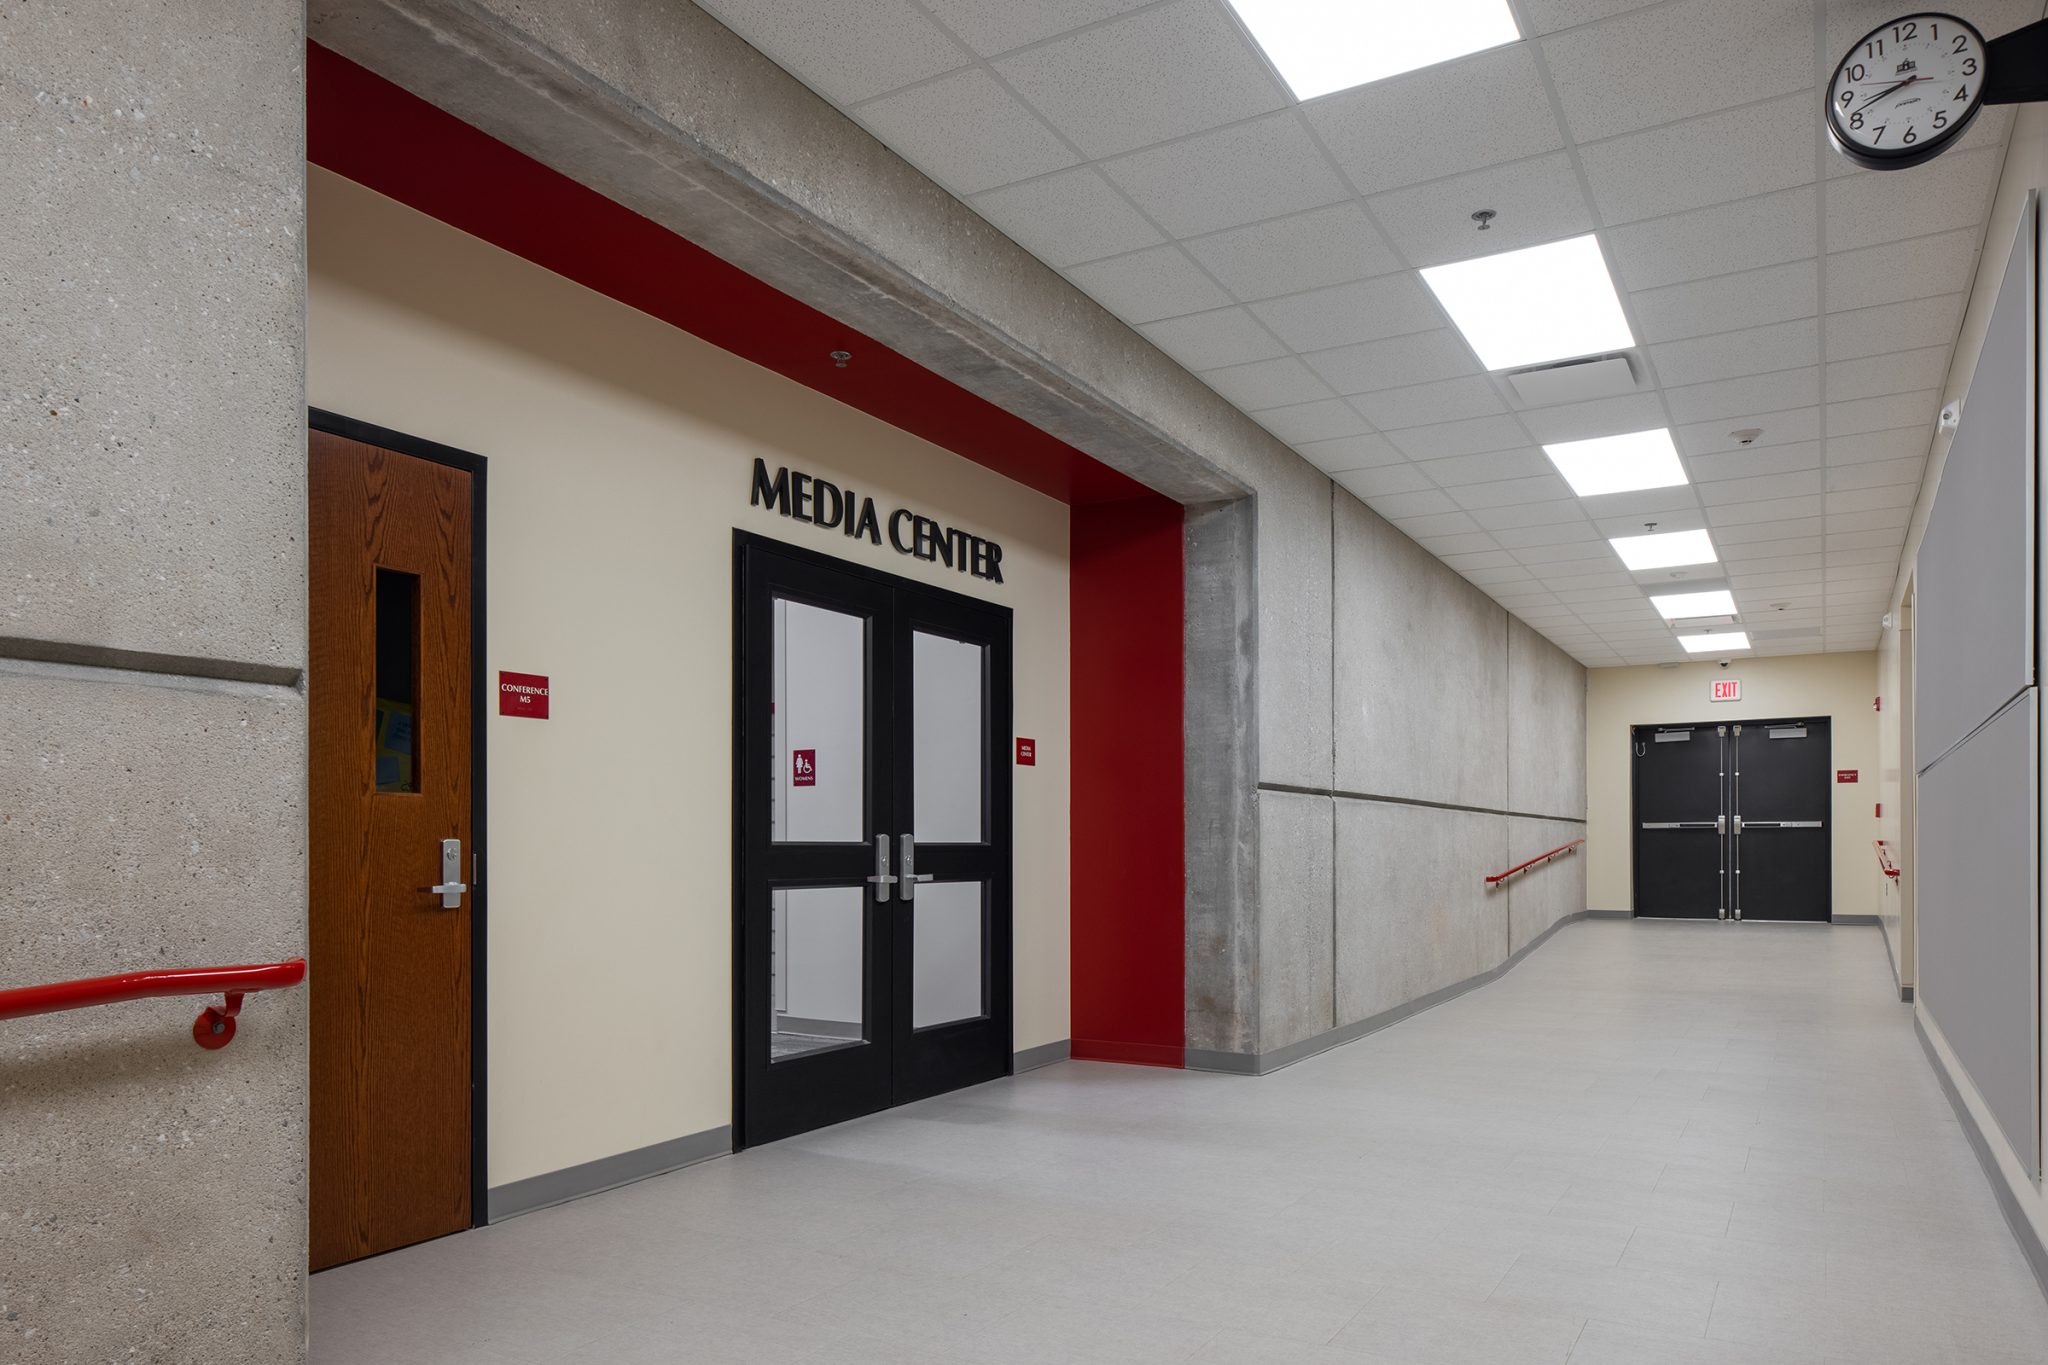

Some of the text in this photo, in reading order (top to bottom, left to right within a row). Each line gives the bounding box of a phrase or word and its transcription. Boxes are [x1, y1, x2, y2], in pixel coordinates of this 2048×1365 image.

[1893, 22, 1918, 43] 12
[1930, 23, 1938, 41] 1
[1866, 39, 1883, 59] 11
[1952, 35, 1968, 54] 2
[1845, 64, 1865, 83] 10
[1962, 58, 1977, 76] 3
[1841, 90, 1854, 108] 9
[1953, 84, 1969, 101] 4
[1850, 112, 1864, 130] 8
[1933, 110, 1947, 129] 5
[1873, 125, 1886, 145] 7
[1903, 125, 1917, 144] 6
[750, 457, 1004, 585] MEDIA CENTER
[501, 683, 549, 695] CONFERENCE
[1715, 681, 1738, 697] EXIT
[520, 695, 531, 703] M5
